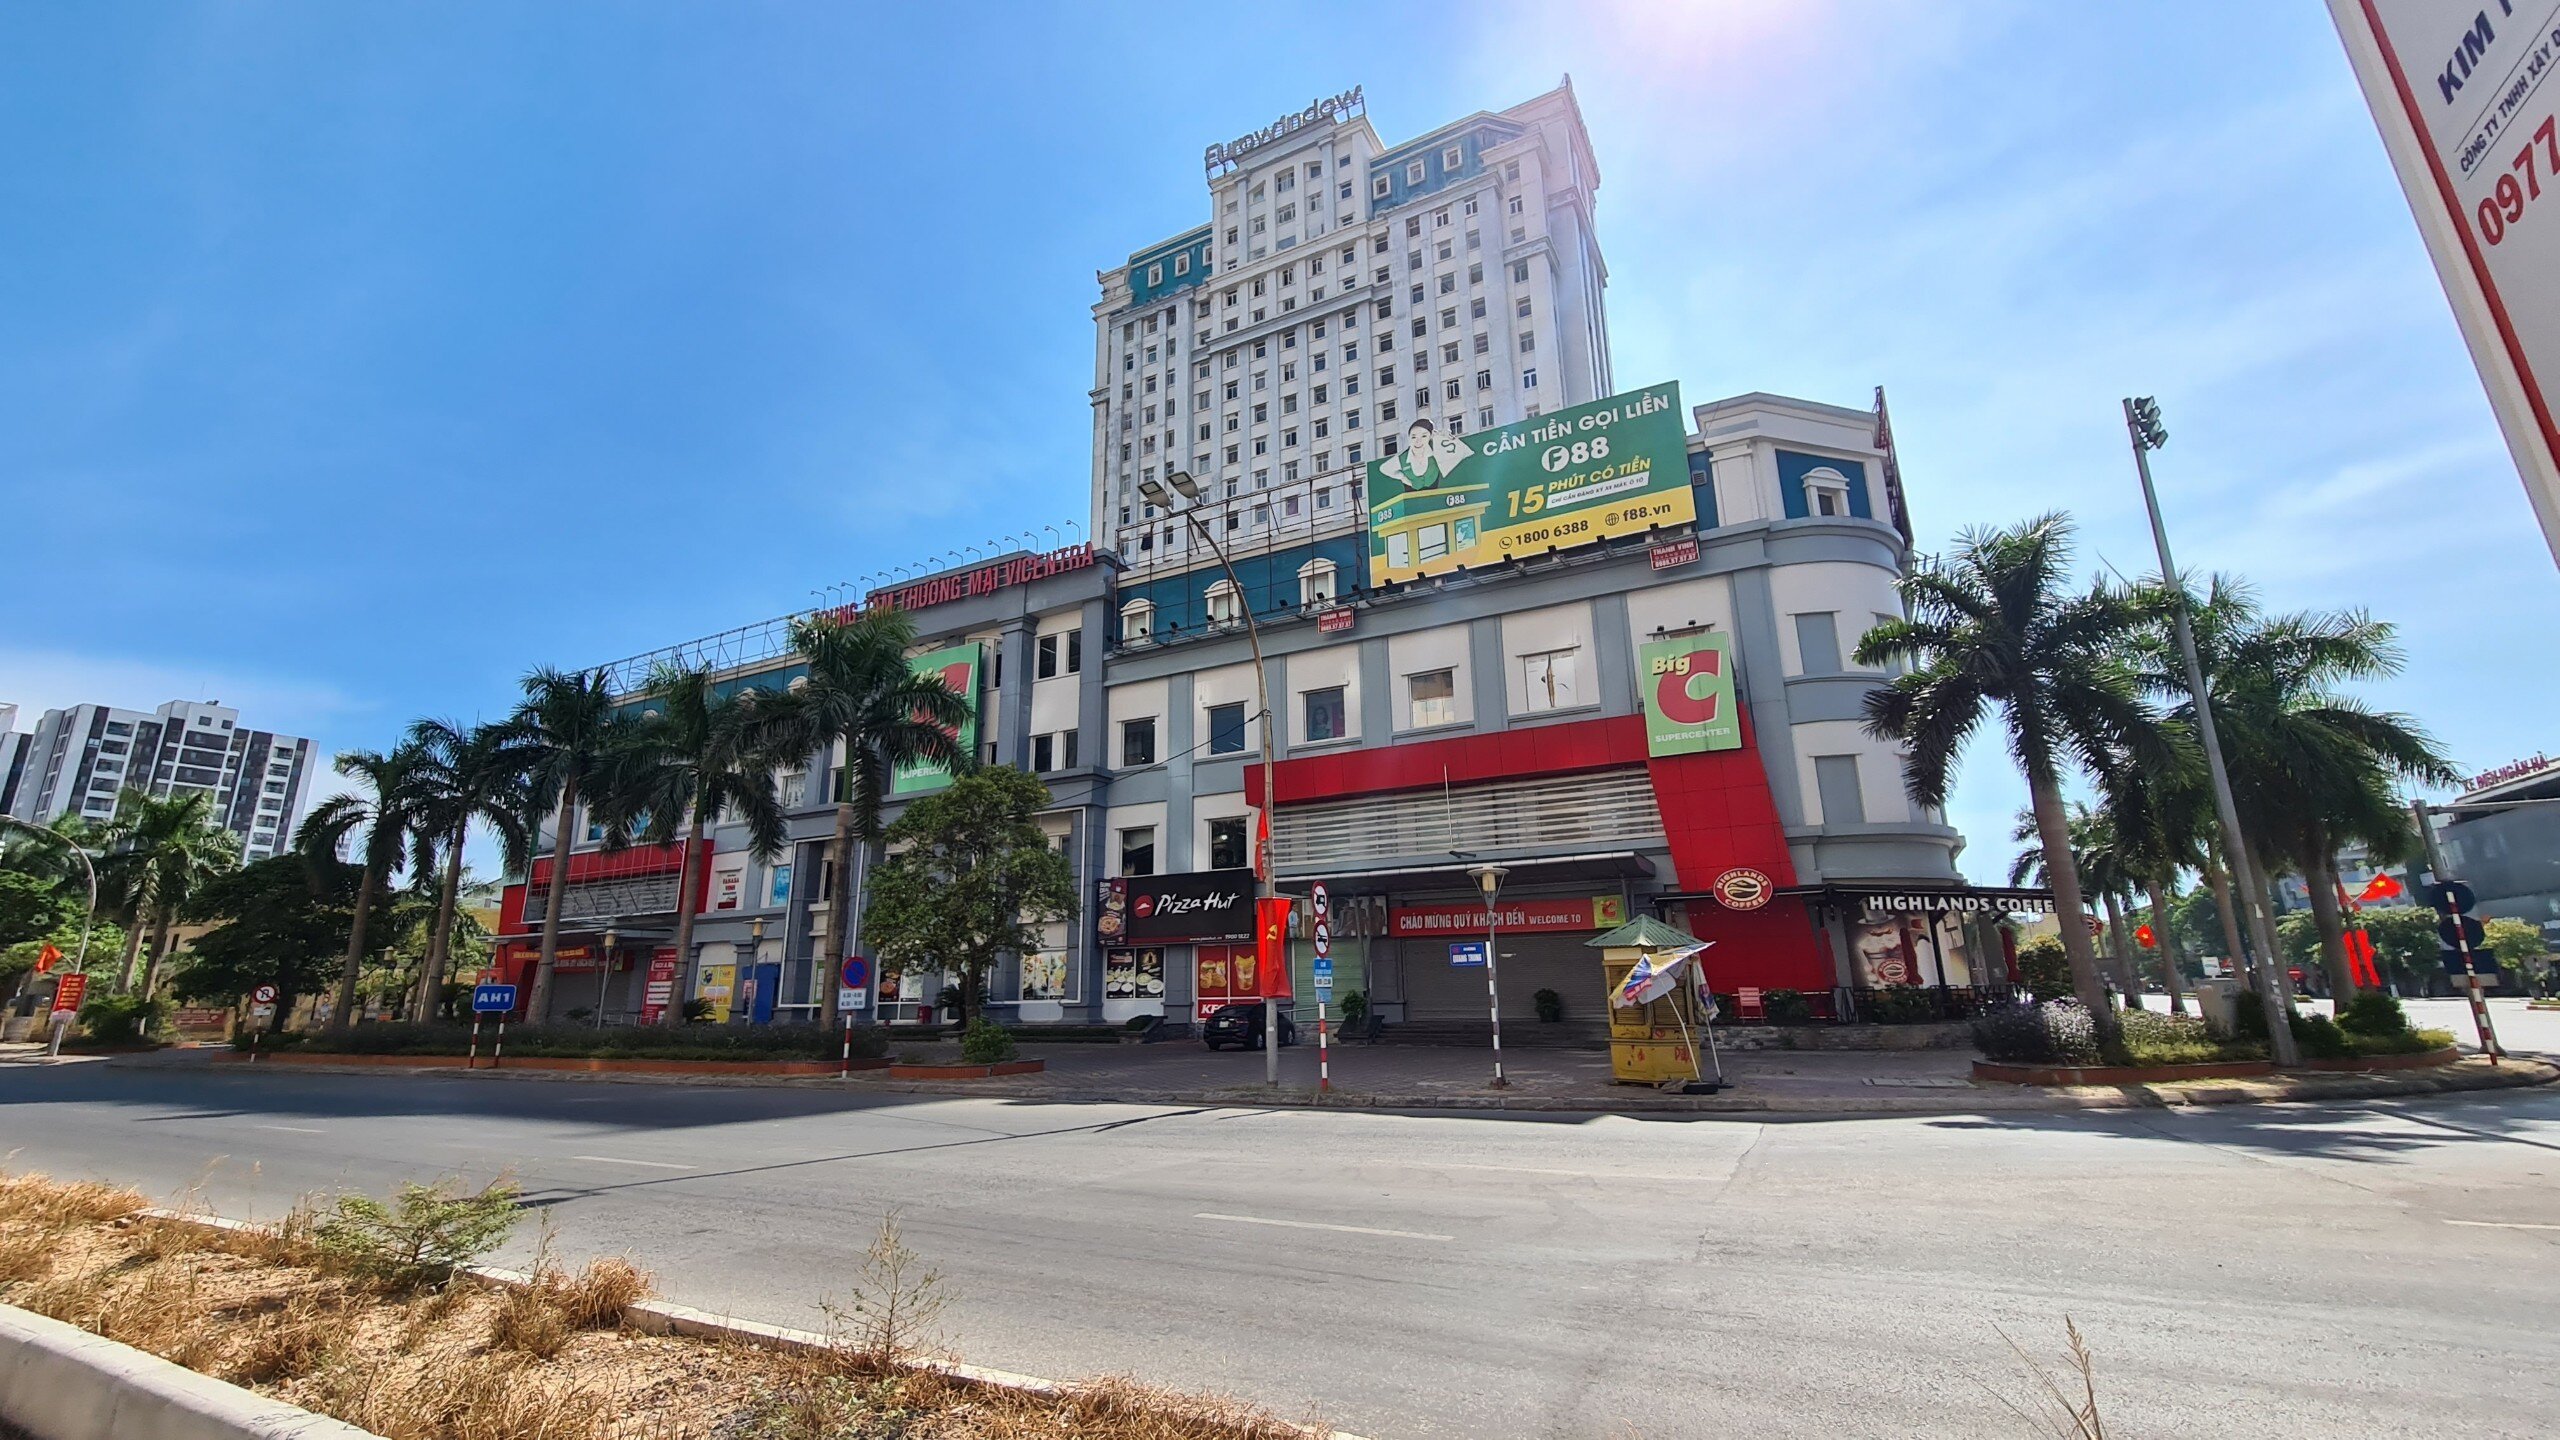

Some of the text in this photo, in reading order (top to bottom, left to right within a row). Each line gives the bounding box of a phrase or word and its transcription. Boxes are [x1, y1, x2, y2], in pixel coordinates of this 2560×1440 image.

[2438, 10, 2496, 105] KIM
[2460, 42, 2552, 172] CÔNG TY TNHH XÂY
[1205, 84, 1363, 166] Eurowindow
[2478, 114, 2560, 246] 0977
[1483, 391, 1669, 456] CẦN TIỀN GỌI LIỀN
[1541, 436, 1610, 472] F88
[1549, 455, 1651, 493] PHÚT CÓ TIỀN
[1507, 484, 1546, 518] 15
[1623, 502, 1671, 522] f88.vn
[1515, 519, 1589, 546] 1800 6388
[968, 566, 999, 597] MẠI
[1004, 541, 1095, 587] VICENTRA
[1652, 653, 1691, 676] Big
[1655, 727, 1731, 743] SUPERCENTER
[1716, 870, 1769, 890] HIGHLANDS
[1154, 891, 1241, 916] Pizza Hut
[1725, 895, 1765, 908] COFFEE
[1869, 896, 1989, 912] HIGHLANDS
[1400, 913, 1423, 930] CHÀO
[1425, 912, 1452, 928] MỪNG
[1454, 911, 1471, 928] QUÝ
[1506, 907, 1525, 926] ĐẾN
[1529, 914, 1569, 925] WELCOME
[1571, 914, 1581, 923] TO
[477, 992, 510, 1003] AH1
